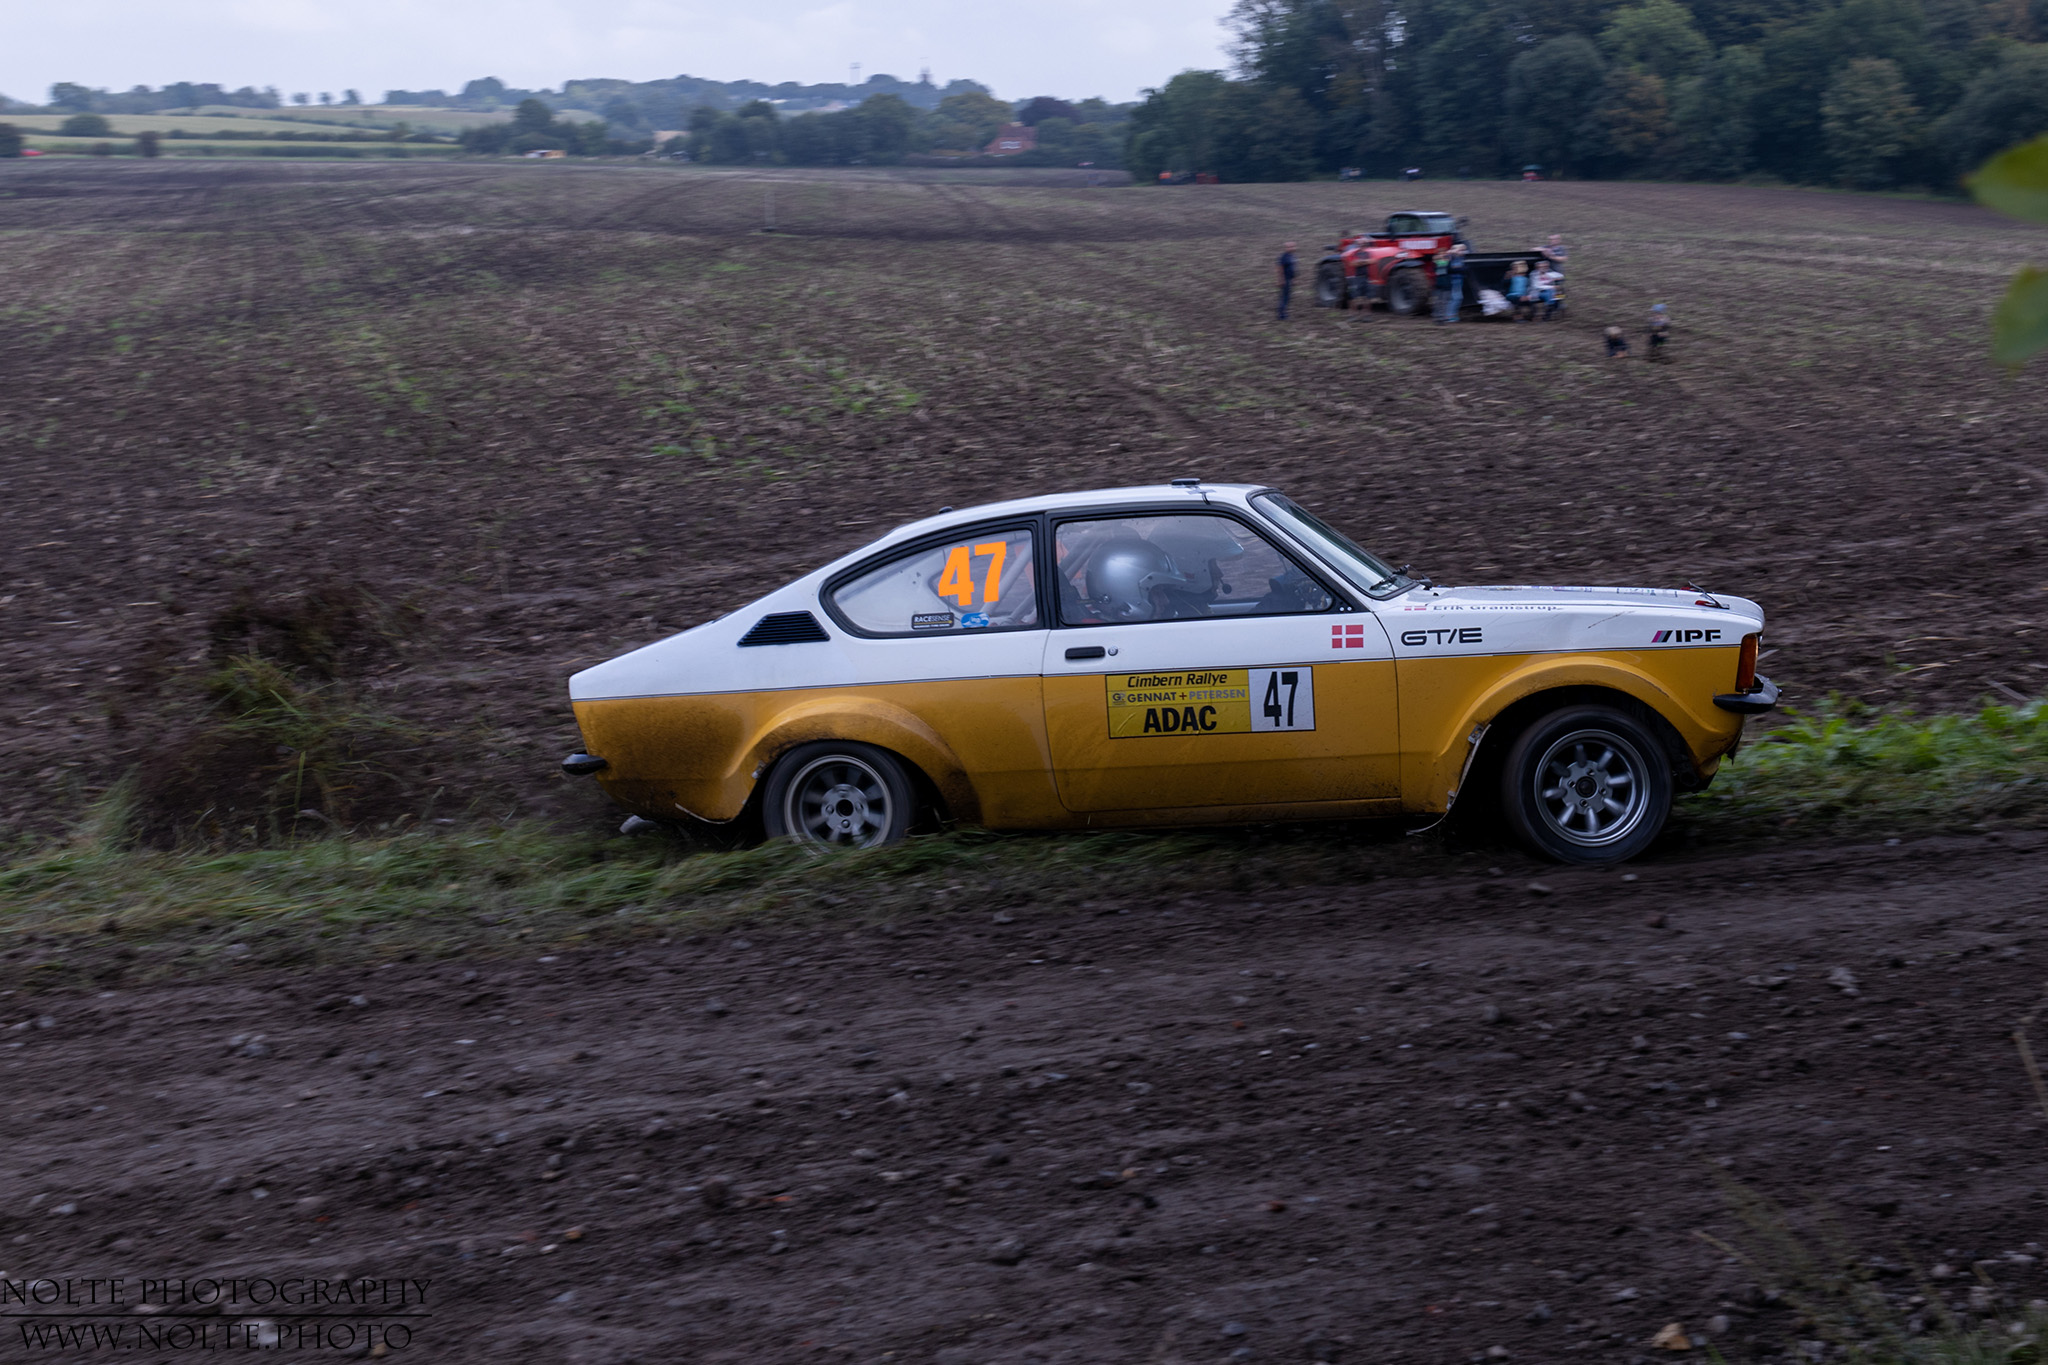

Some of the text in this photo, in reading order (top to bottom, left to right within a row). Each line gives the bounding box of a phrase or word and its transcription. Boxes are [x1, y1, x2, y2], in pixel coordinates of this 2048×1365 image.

[938, 541, 1007, 606] 47
[914, 615, 950, 623] RACESENSE
[1401, 627, 1483, 647] GT/E
[1127, 672, 1228, 688] Cimbern Rallye
[1127, 691, 1177, 703] GENNAT
[1189, 688, 1246, 700] PETERSEN
[1263, 671, 1299, 727] 47
[1143, 705, 1217, 734] ADAC
